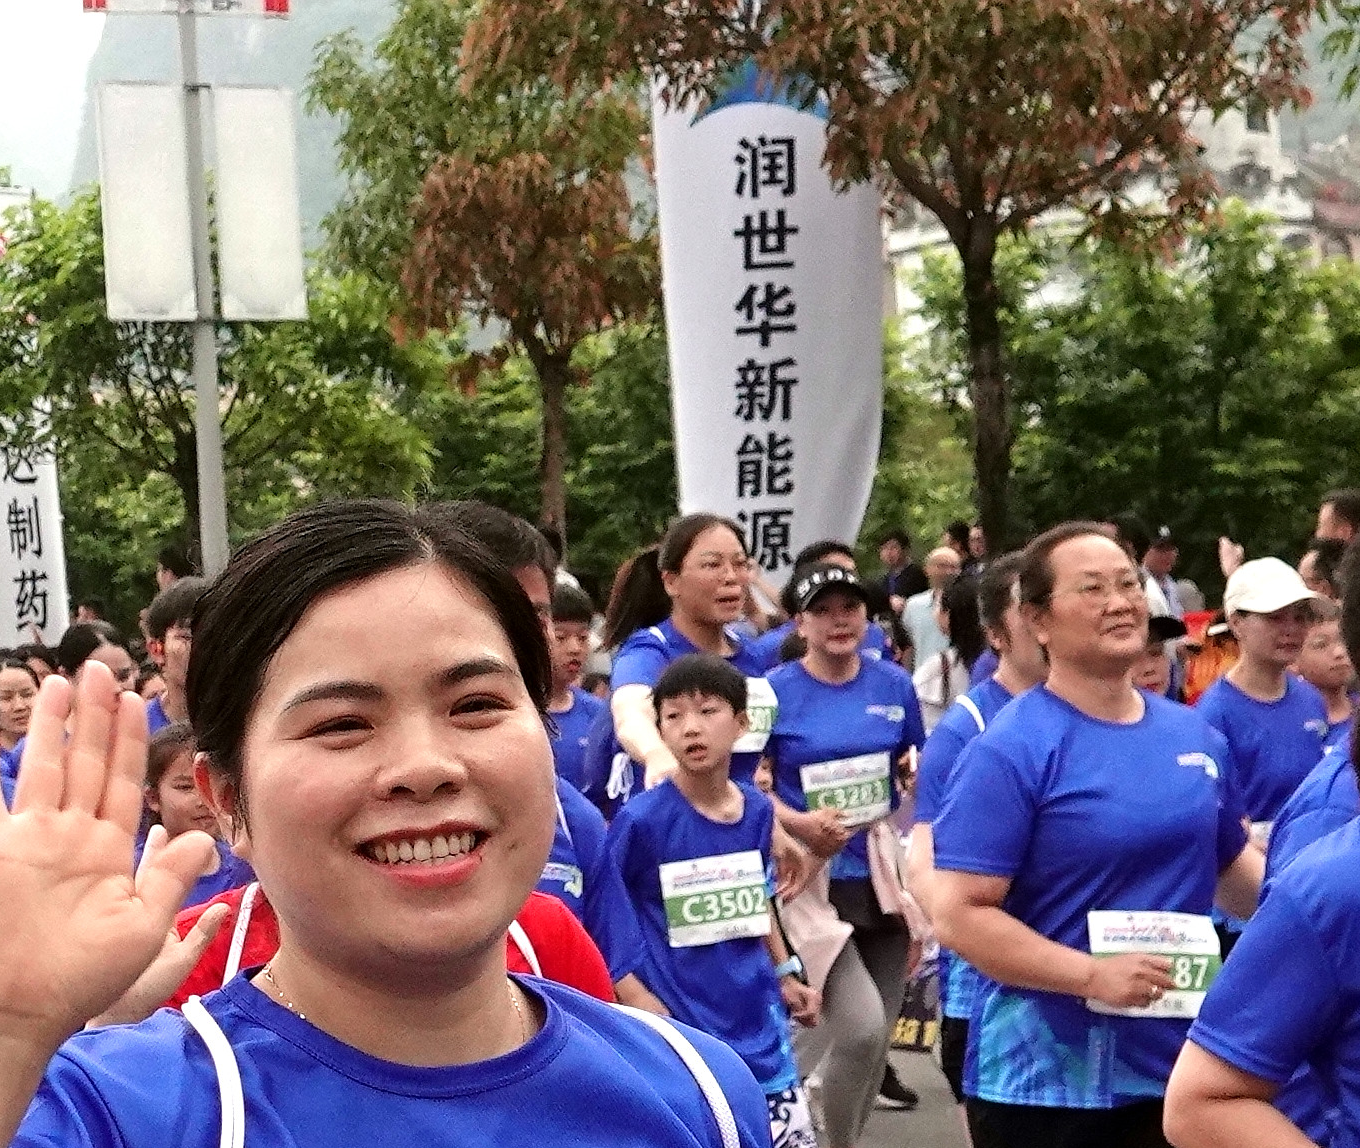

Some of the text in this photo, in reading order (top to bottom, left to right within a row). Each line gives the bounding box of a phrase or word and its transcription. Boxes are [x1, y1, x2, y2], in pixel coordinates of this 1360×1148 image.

[734, 136, 799, 570] 润世华新能源
[682, 887, 768, 923] C3502
